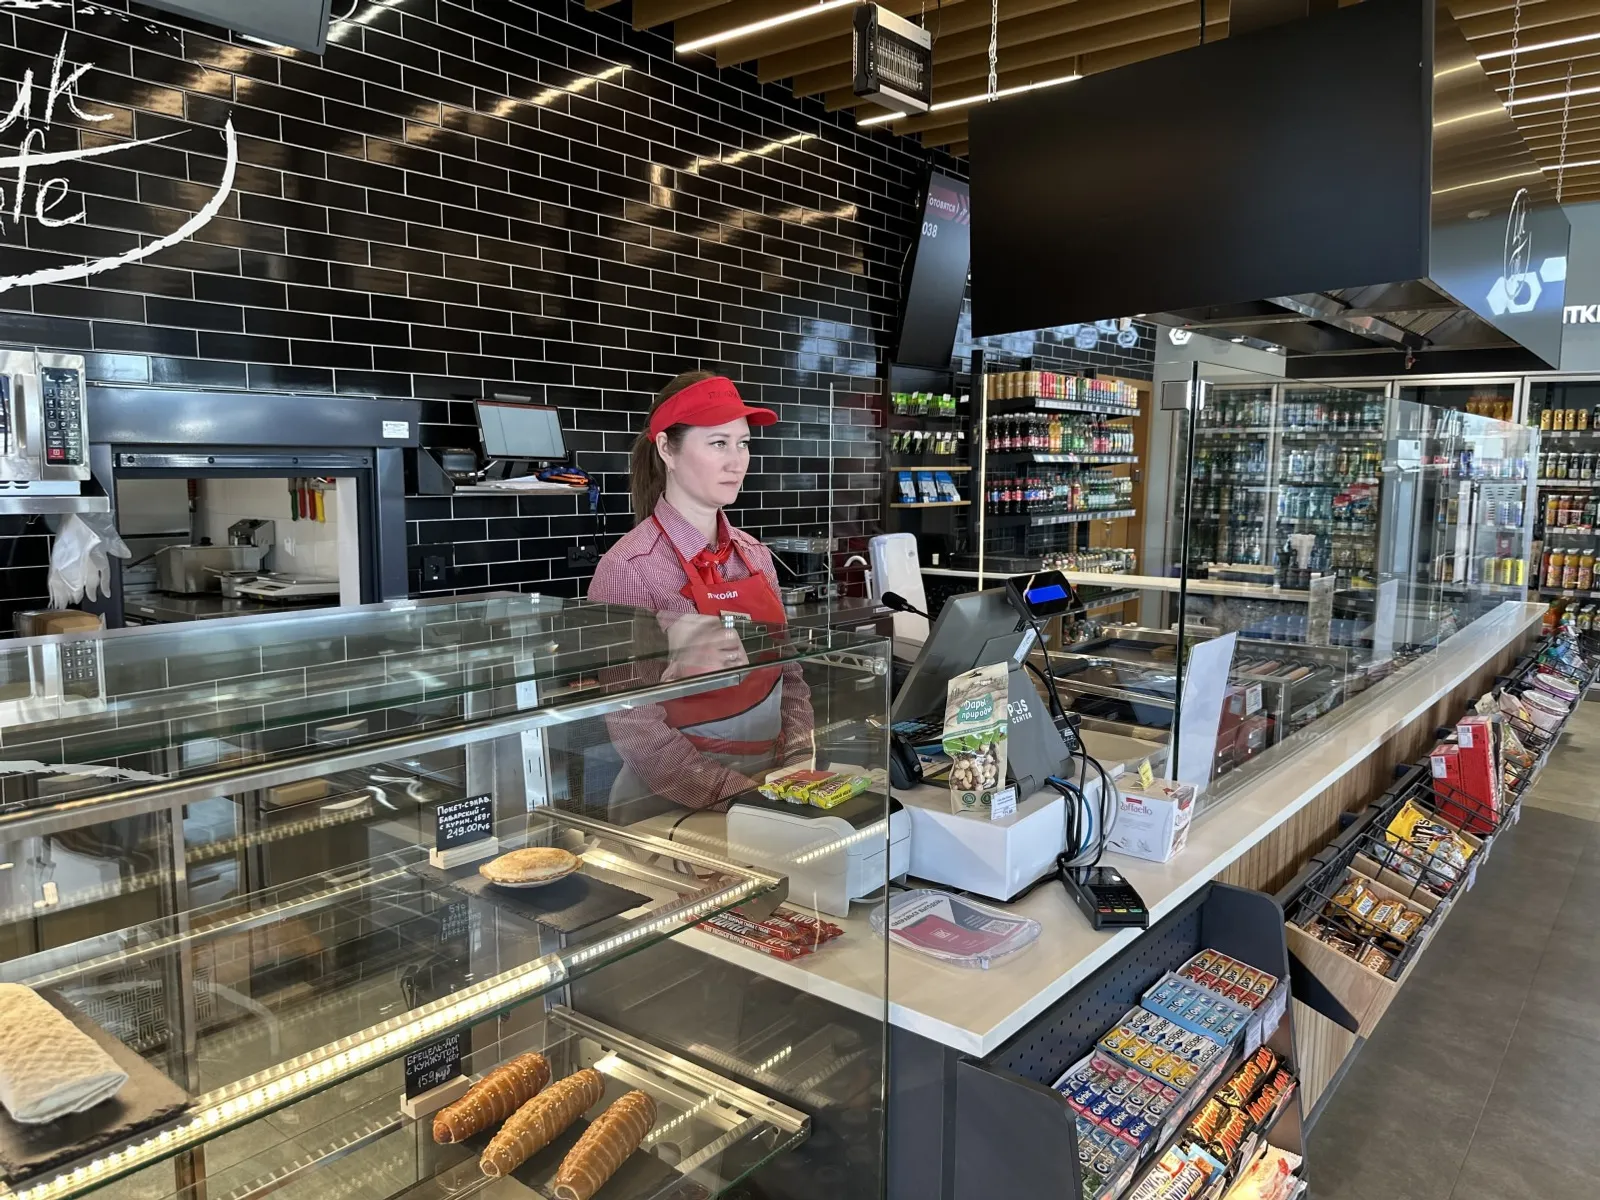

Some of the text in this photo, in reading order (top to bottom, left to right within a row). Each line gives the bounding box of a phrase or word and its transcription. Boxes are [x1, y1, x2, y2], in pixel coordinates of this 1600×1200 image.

[922, 221, 938, 238] 038
[964, 699, 986, 711] Дары
[961, 706, 993, 720] природы
[1011, 711, 1033, 724] CENTER
[1132, 1012, 1153, 1029] eclipse
[1148, 1020, 1170, 1037] eclipse
[1164, 1028, 1187, 1046] eclipse
[1181, 1036, 1204, 1054] eclipse
[1200, 1044, 1221, 1062] eclipse
[1078, 1067, 1096, 1082] Orbit
[1074, 1090, 1093, 1105] Orbit
[1092, 1101, 1110, 1116] Orbit
[1111, 1111, 1129, 1127] Orbit
[1129, 1122, 1148, 1137] Orbit
